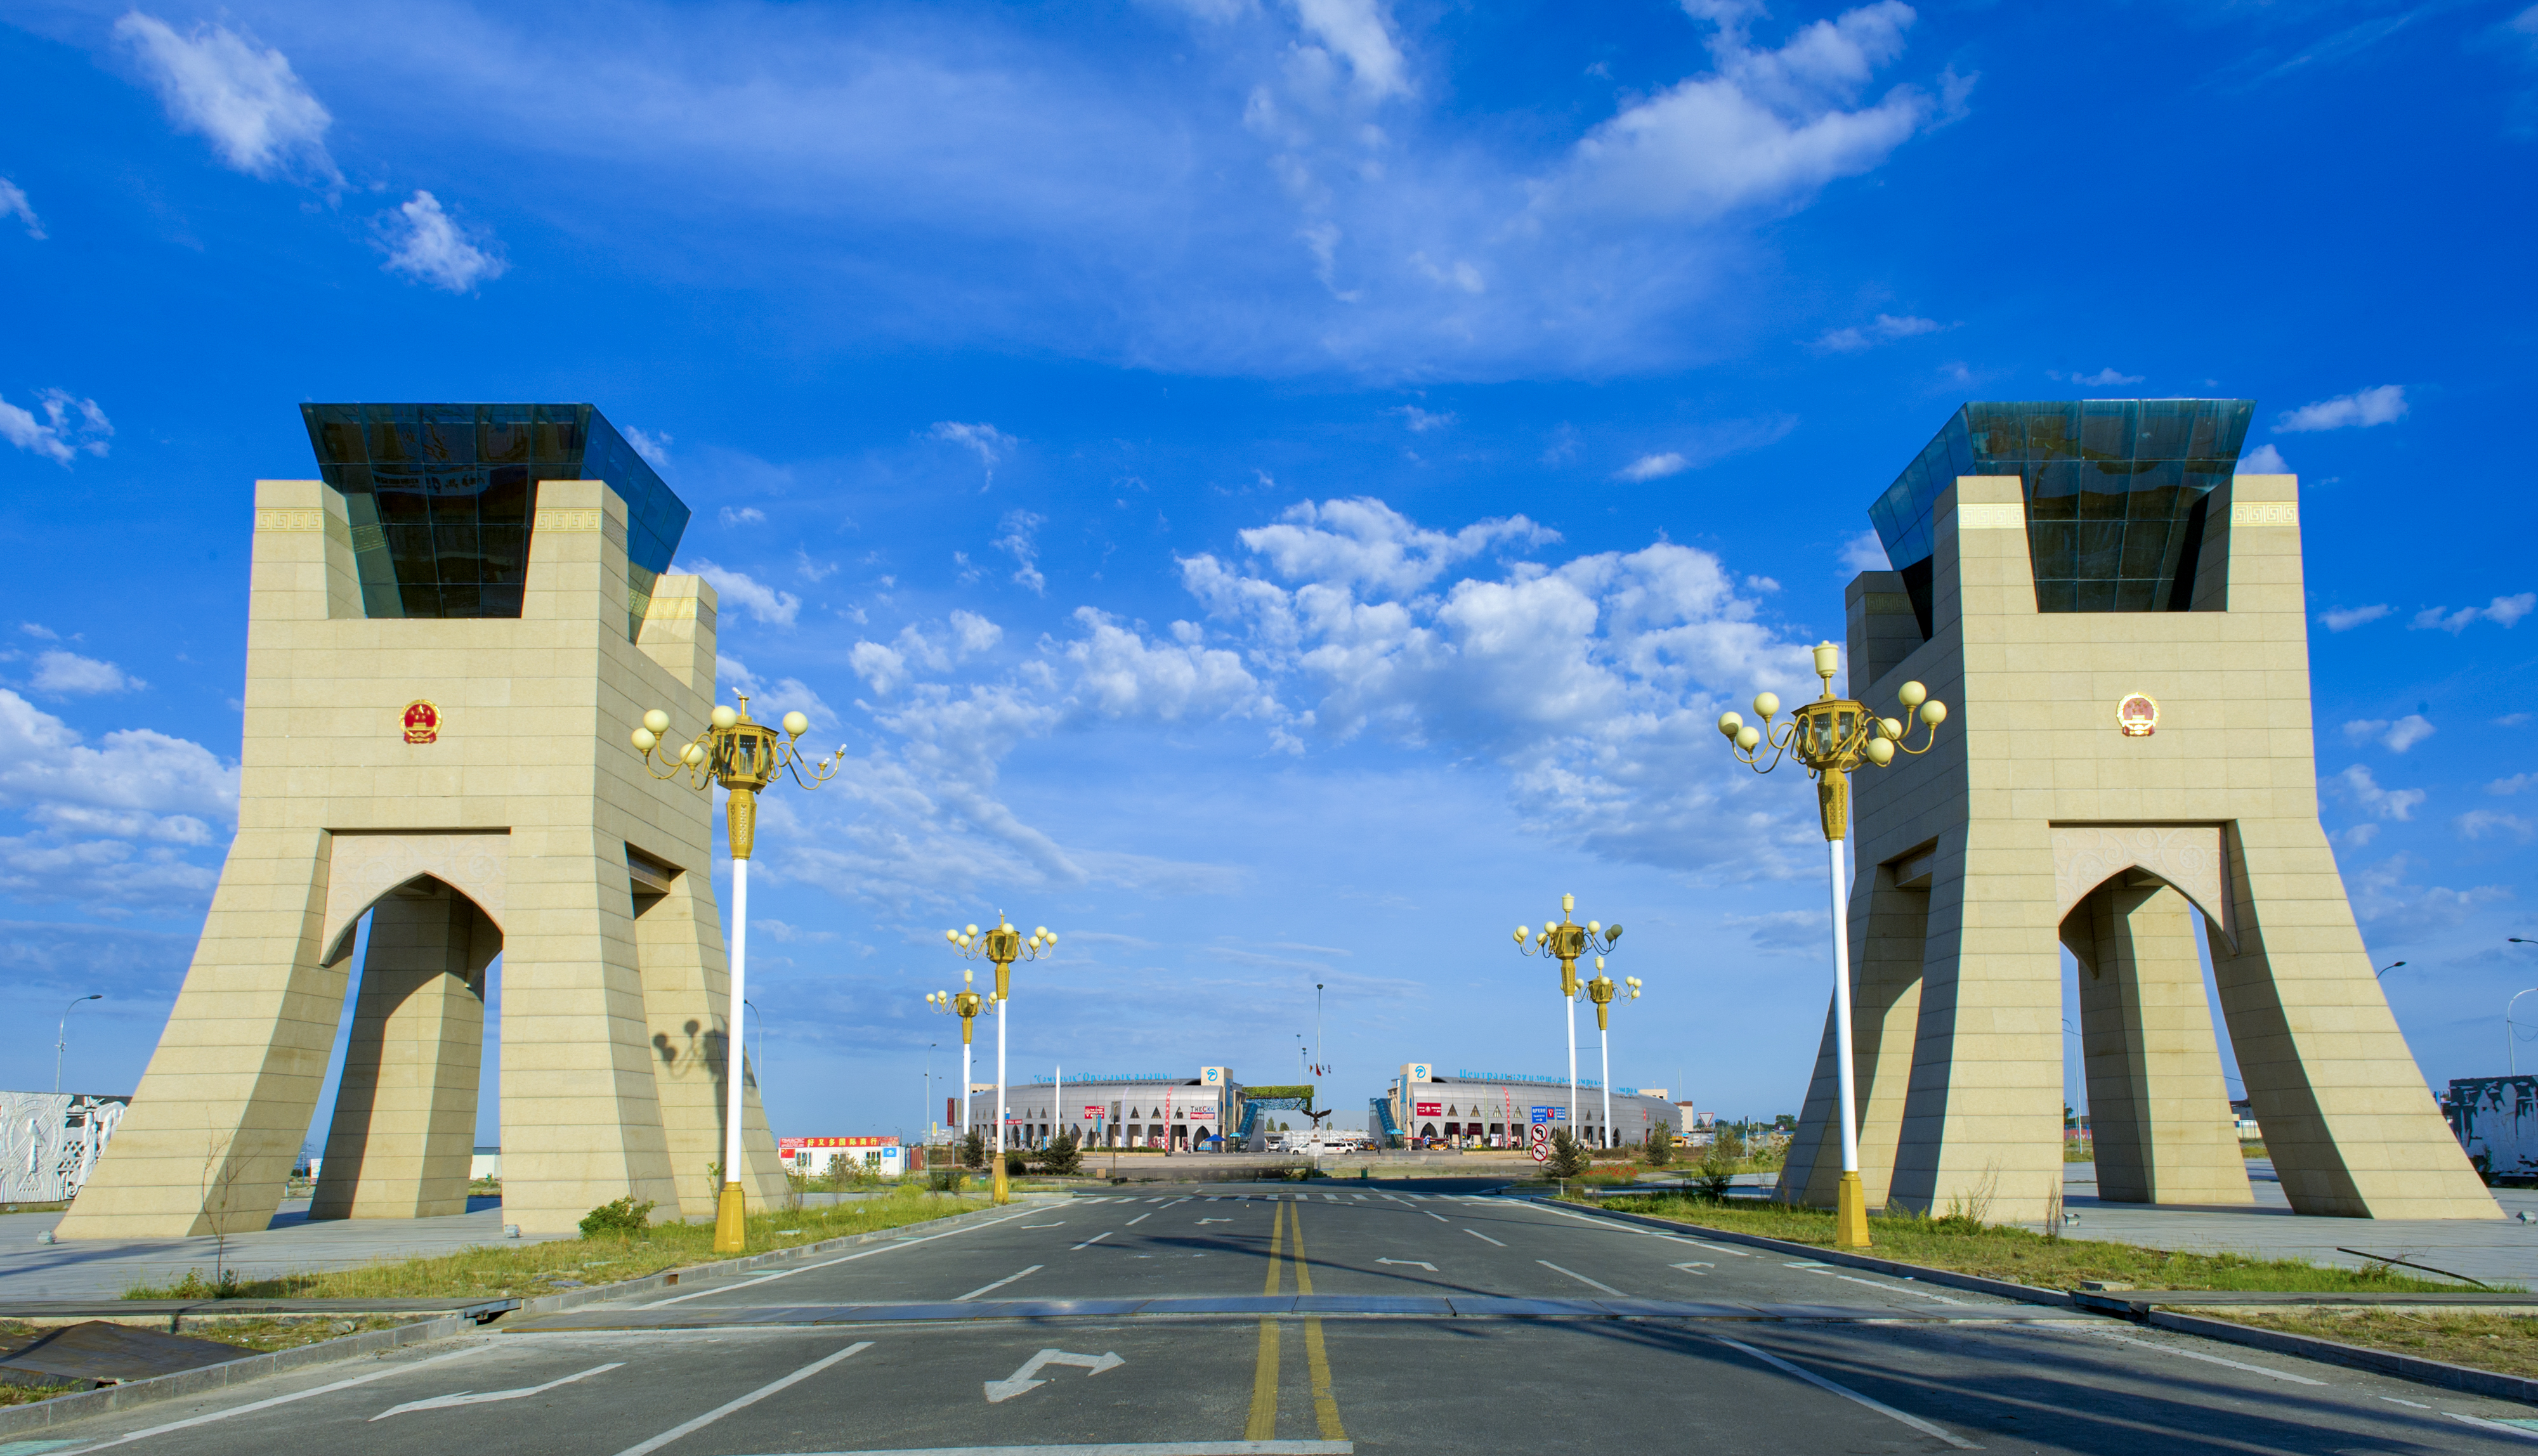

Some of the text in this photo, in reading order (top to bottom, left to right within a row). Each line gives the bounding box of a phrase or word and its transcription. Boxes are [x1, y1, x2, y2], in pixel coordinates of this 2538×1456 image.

[807, 1138, 877, 1147] 好又多国际商行
